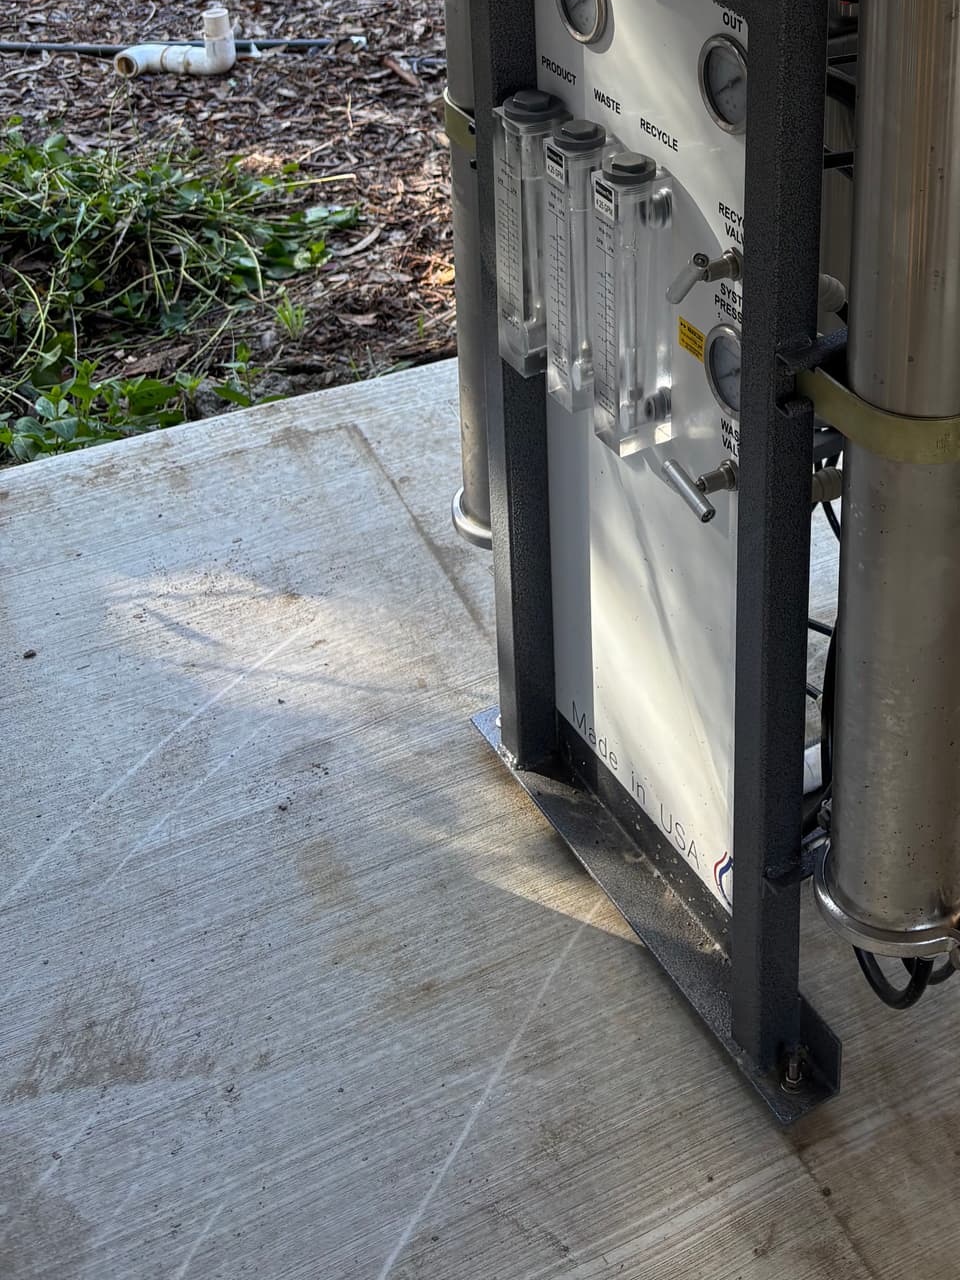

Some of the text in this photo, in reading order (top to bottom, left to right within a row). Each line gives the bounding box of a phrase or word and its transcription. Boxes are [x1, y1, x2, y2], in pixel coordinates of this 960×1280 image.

[722, 11, 743, 32] OUT
[541, 55, 576, 85] PRODUCT
[593, 87, 621, 115] WASTE
[640, 117, 679, 152] RECYCLE
[721, 434, 740, 457] VAL
[572, 700, 700, 869] Made in USA
